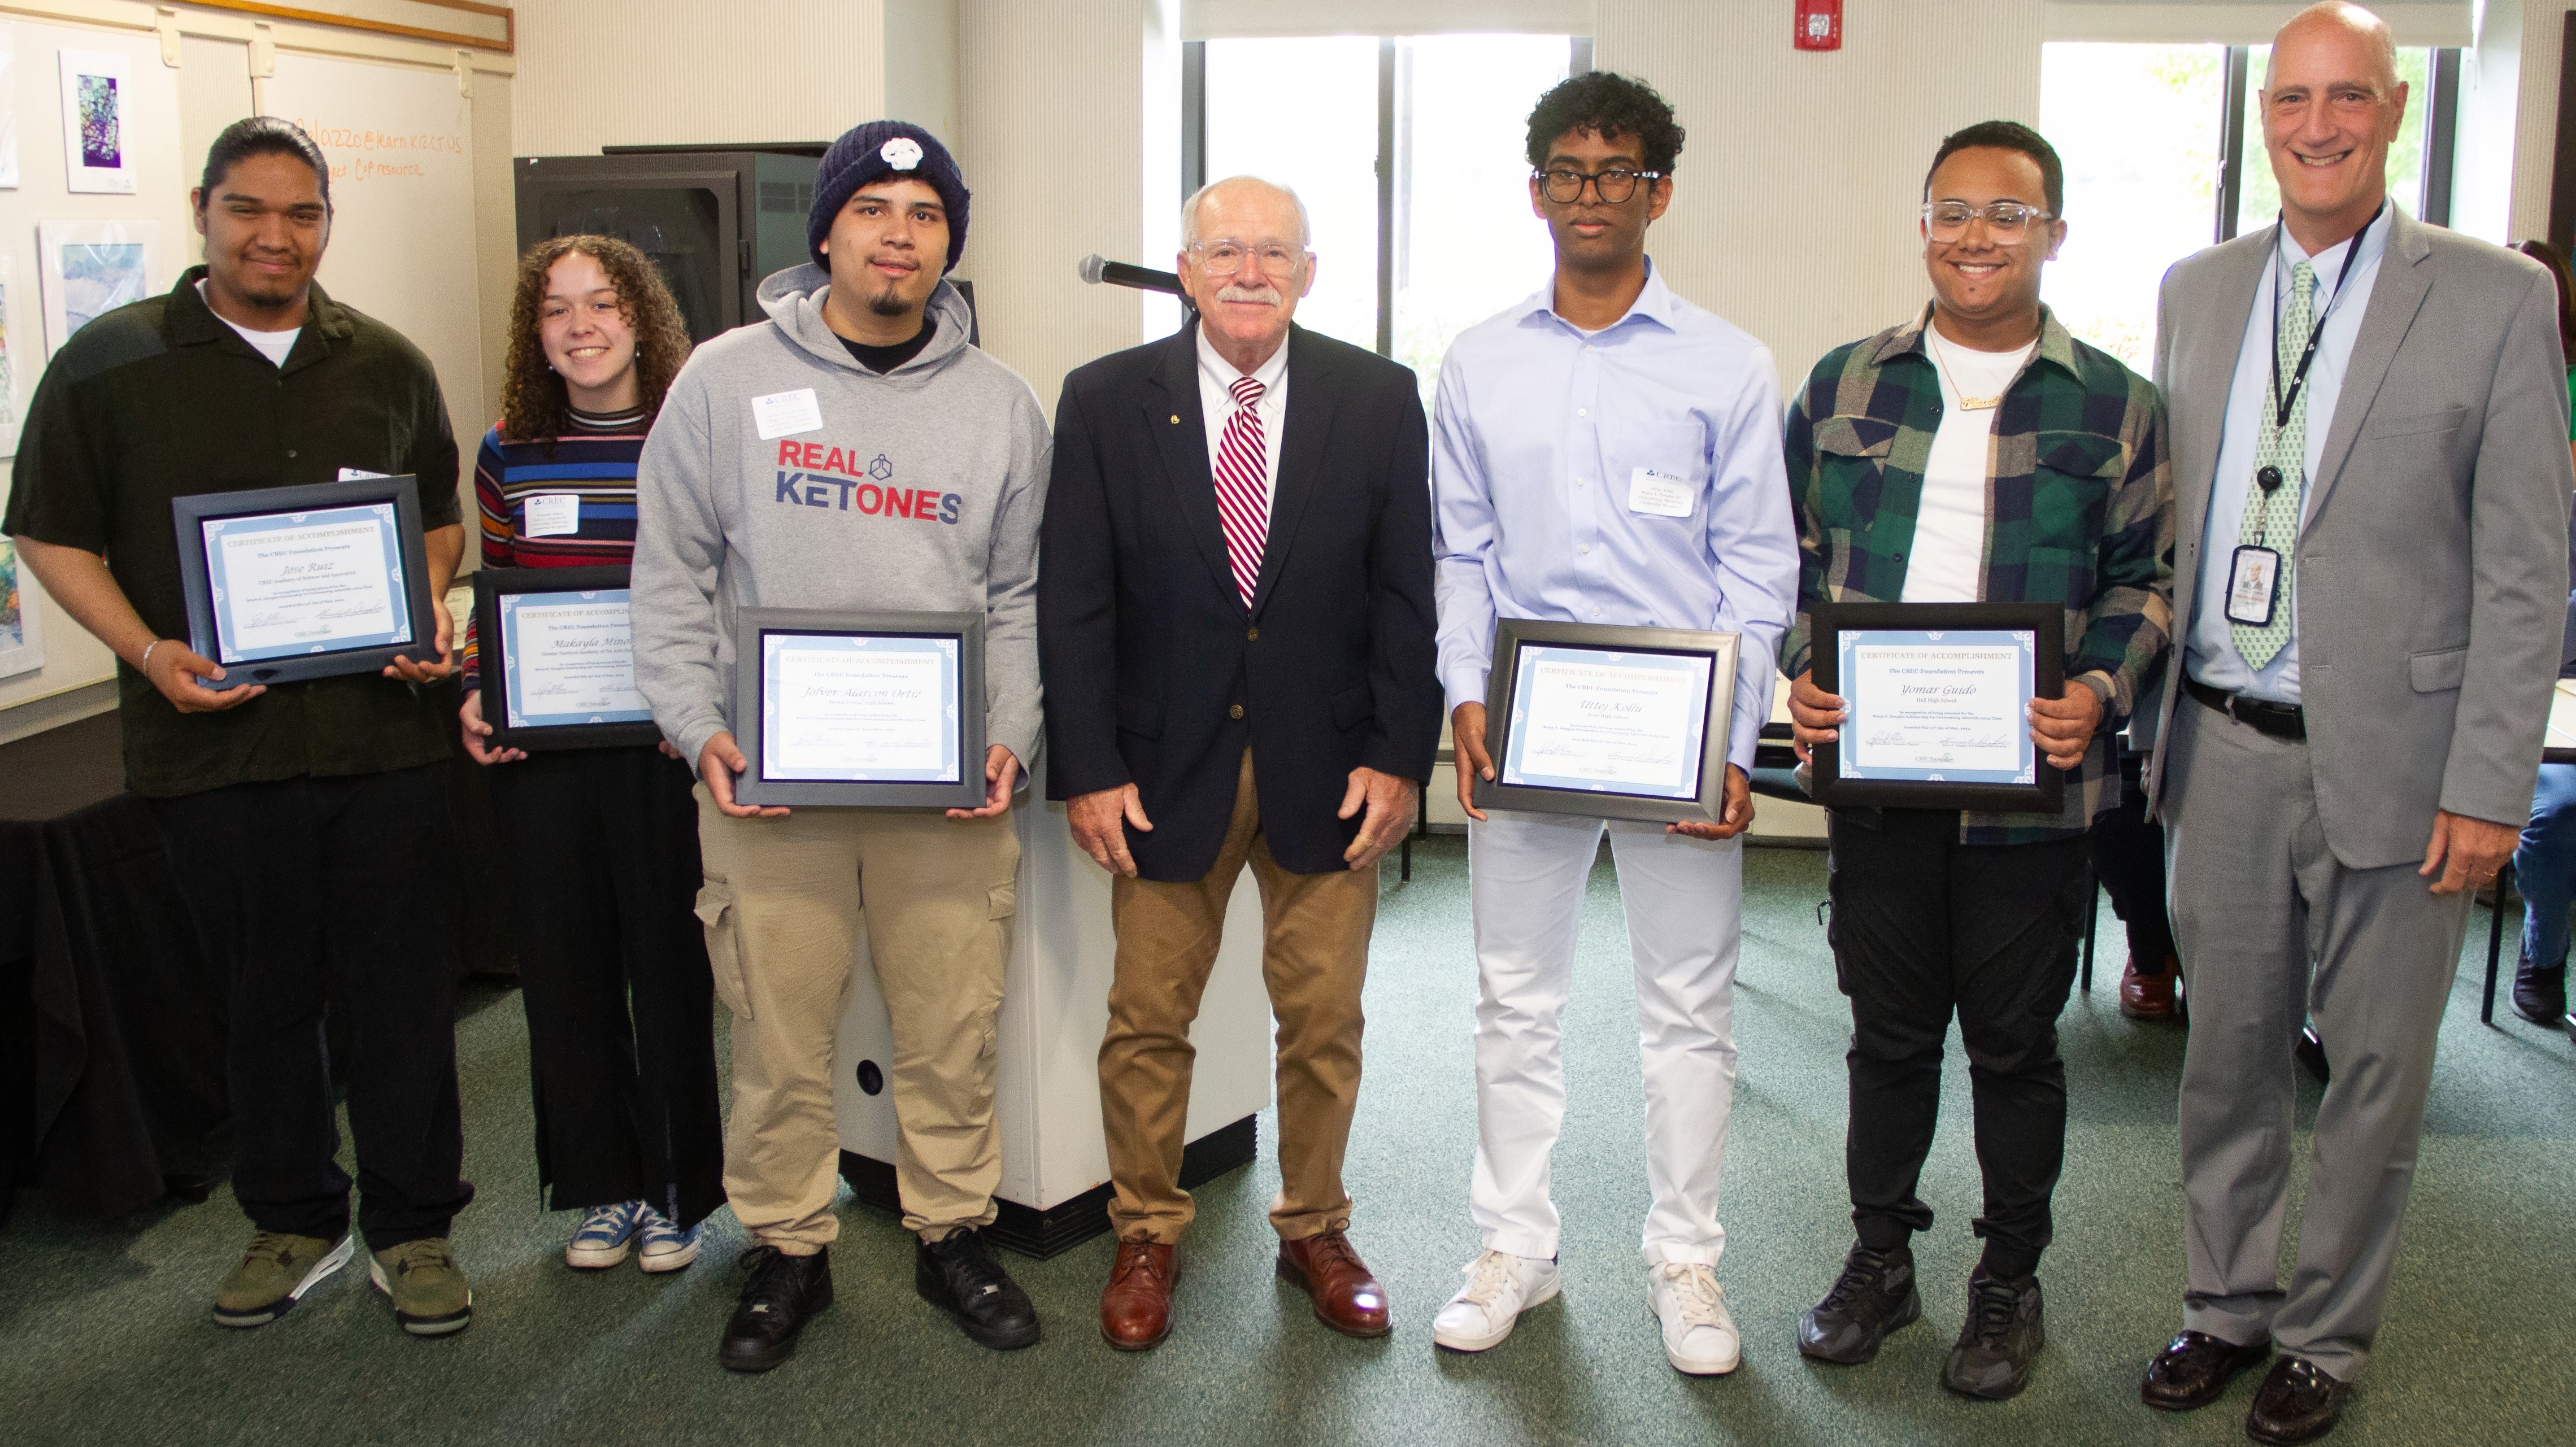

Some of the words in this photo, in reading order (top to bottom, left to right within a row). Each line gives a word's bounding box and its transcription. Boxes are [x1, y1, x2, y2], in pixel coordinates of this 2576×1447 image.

[778, 439, 864, 477] REAL
[776, 470, 962, 525] KETONES
[228, 536, 284, 547] CERTIFICATE
[298, 526, 375, 541] ACCOMPLISHMENT
[280, 565, 304, 577] Jose
[308, 563, 334, 573] Ruiz
[522, 609, 571, 618] CERTIFICATE
[551, 637, 599, 650] Makayla
[1541, 667, 1593, 677] CERTIFICATE
[1609, 672, 1686, 683] ACCOMPLISHMENT
[841, 687, 889, 698] Alarcon
[892, 689, 921, 698] Ortiz
[1900, 684, 1940, 696] Yomar
[1942, 684, 1977, 696] Guido
[1581, 700, 1608, 713] Uttej
